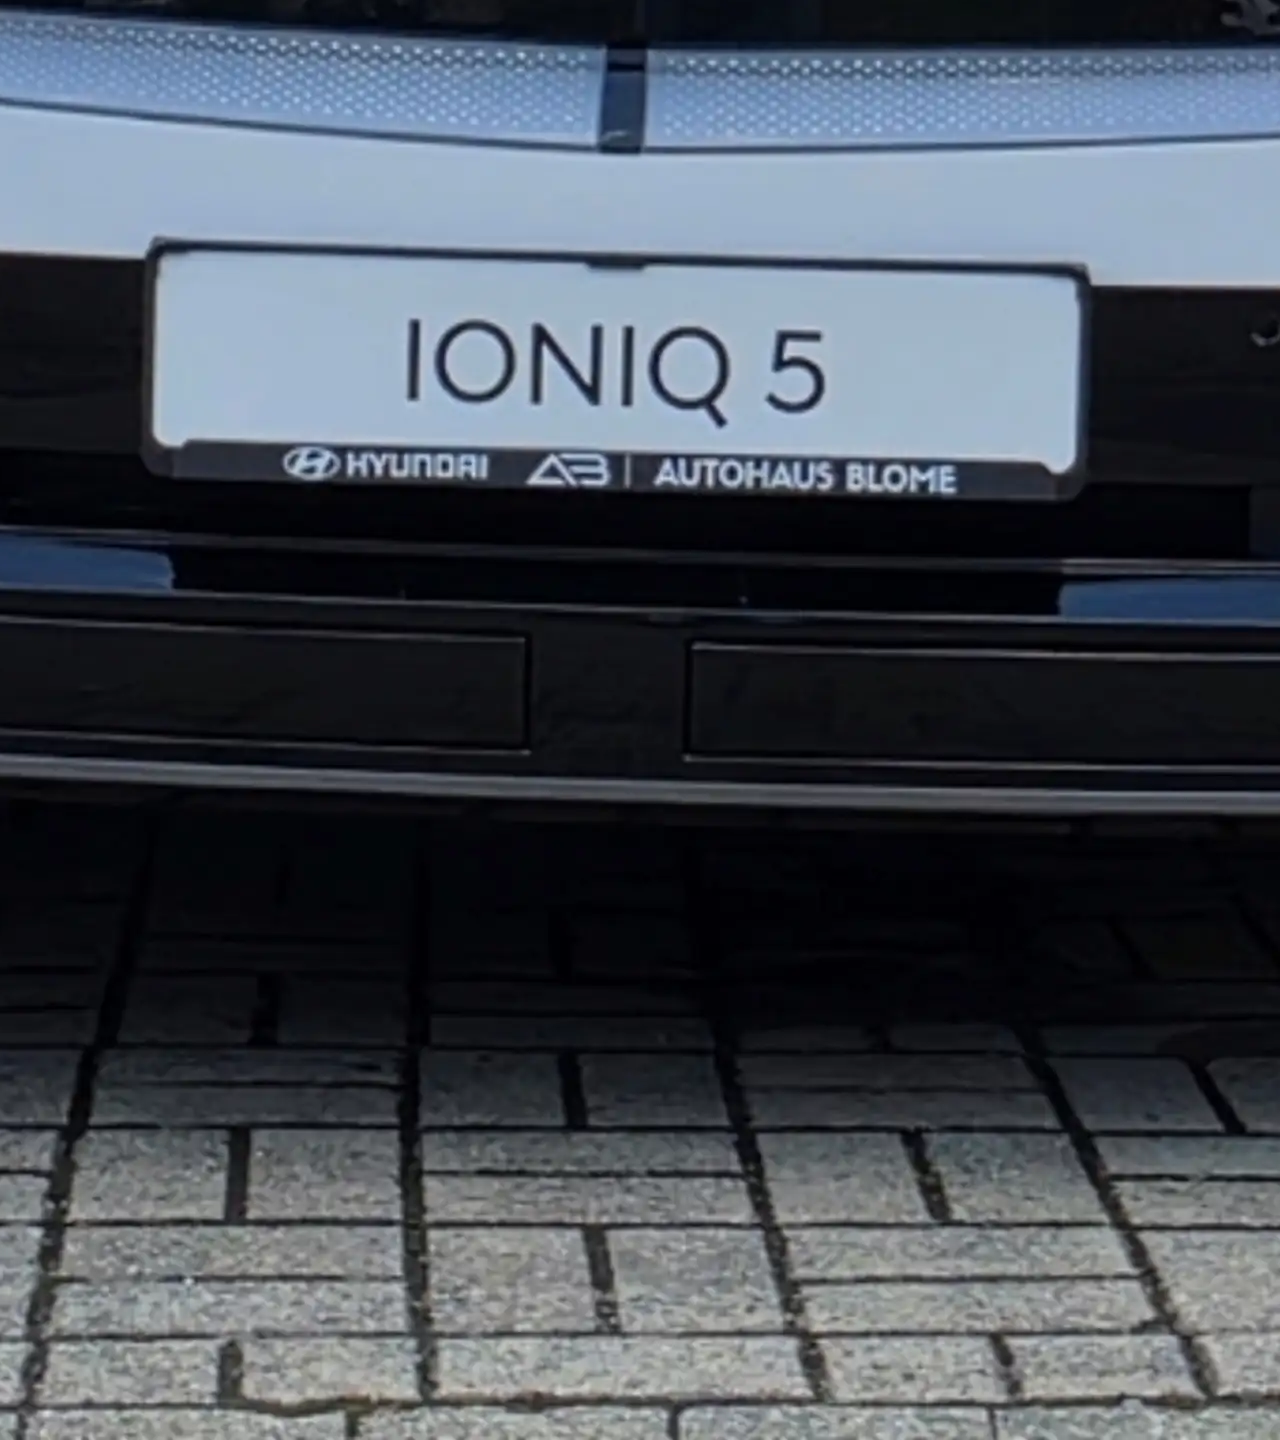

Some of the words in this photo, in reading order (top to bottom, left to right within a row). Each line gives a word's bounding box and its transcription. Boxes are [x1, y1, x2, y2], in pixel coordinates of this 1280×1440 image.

[407, 318, 730, 428] IONIQ
[765, 330, 825, 414] 5
[346, 452, 489, 480] HYUNDAI
[654, 459, 834, 491] AUTOHAUS
[846, 464, 957, 494] BLOME
